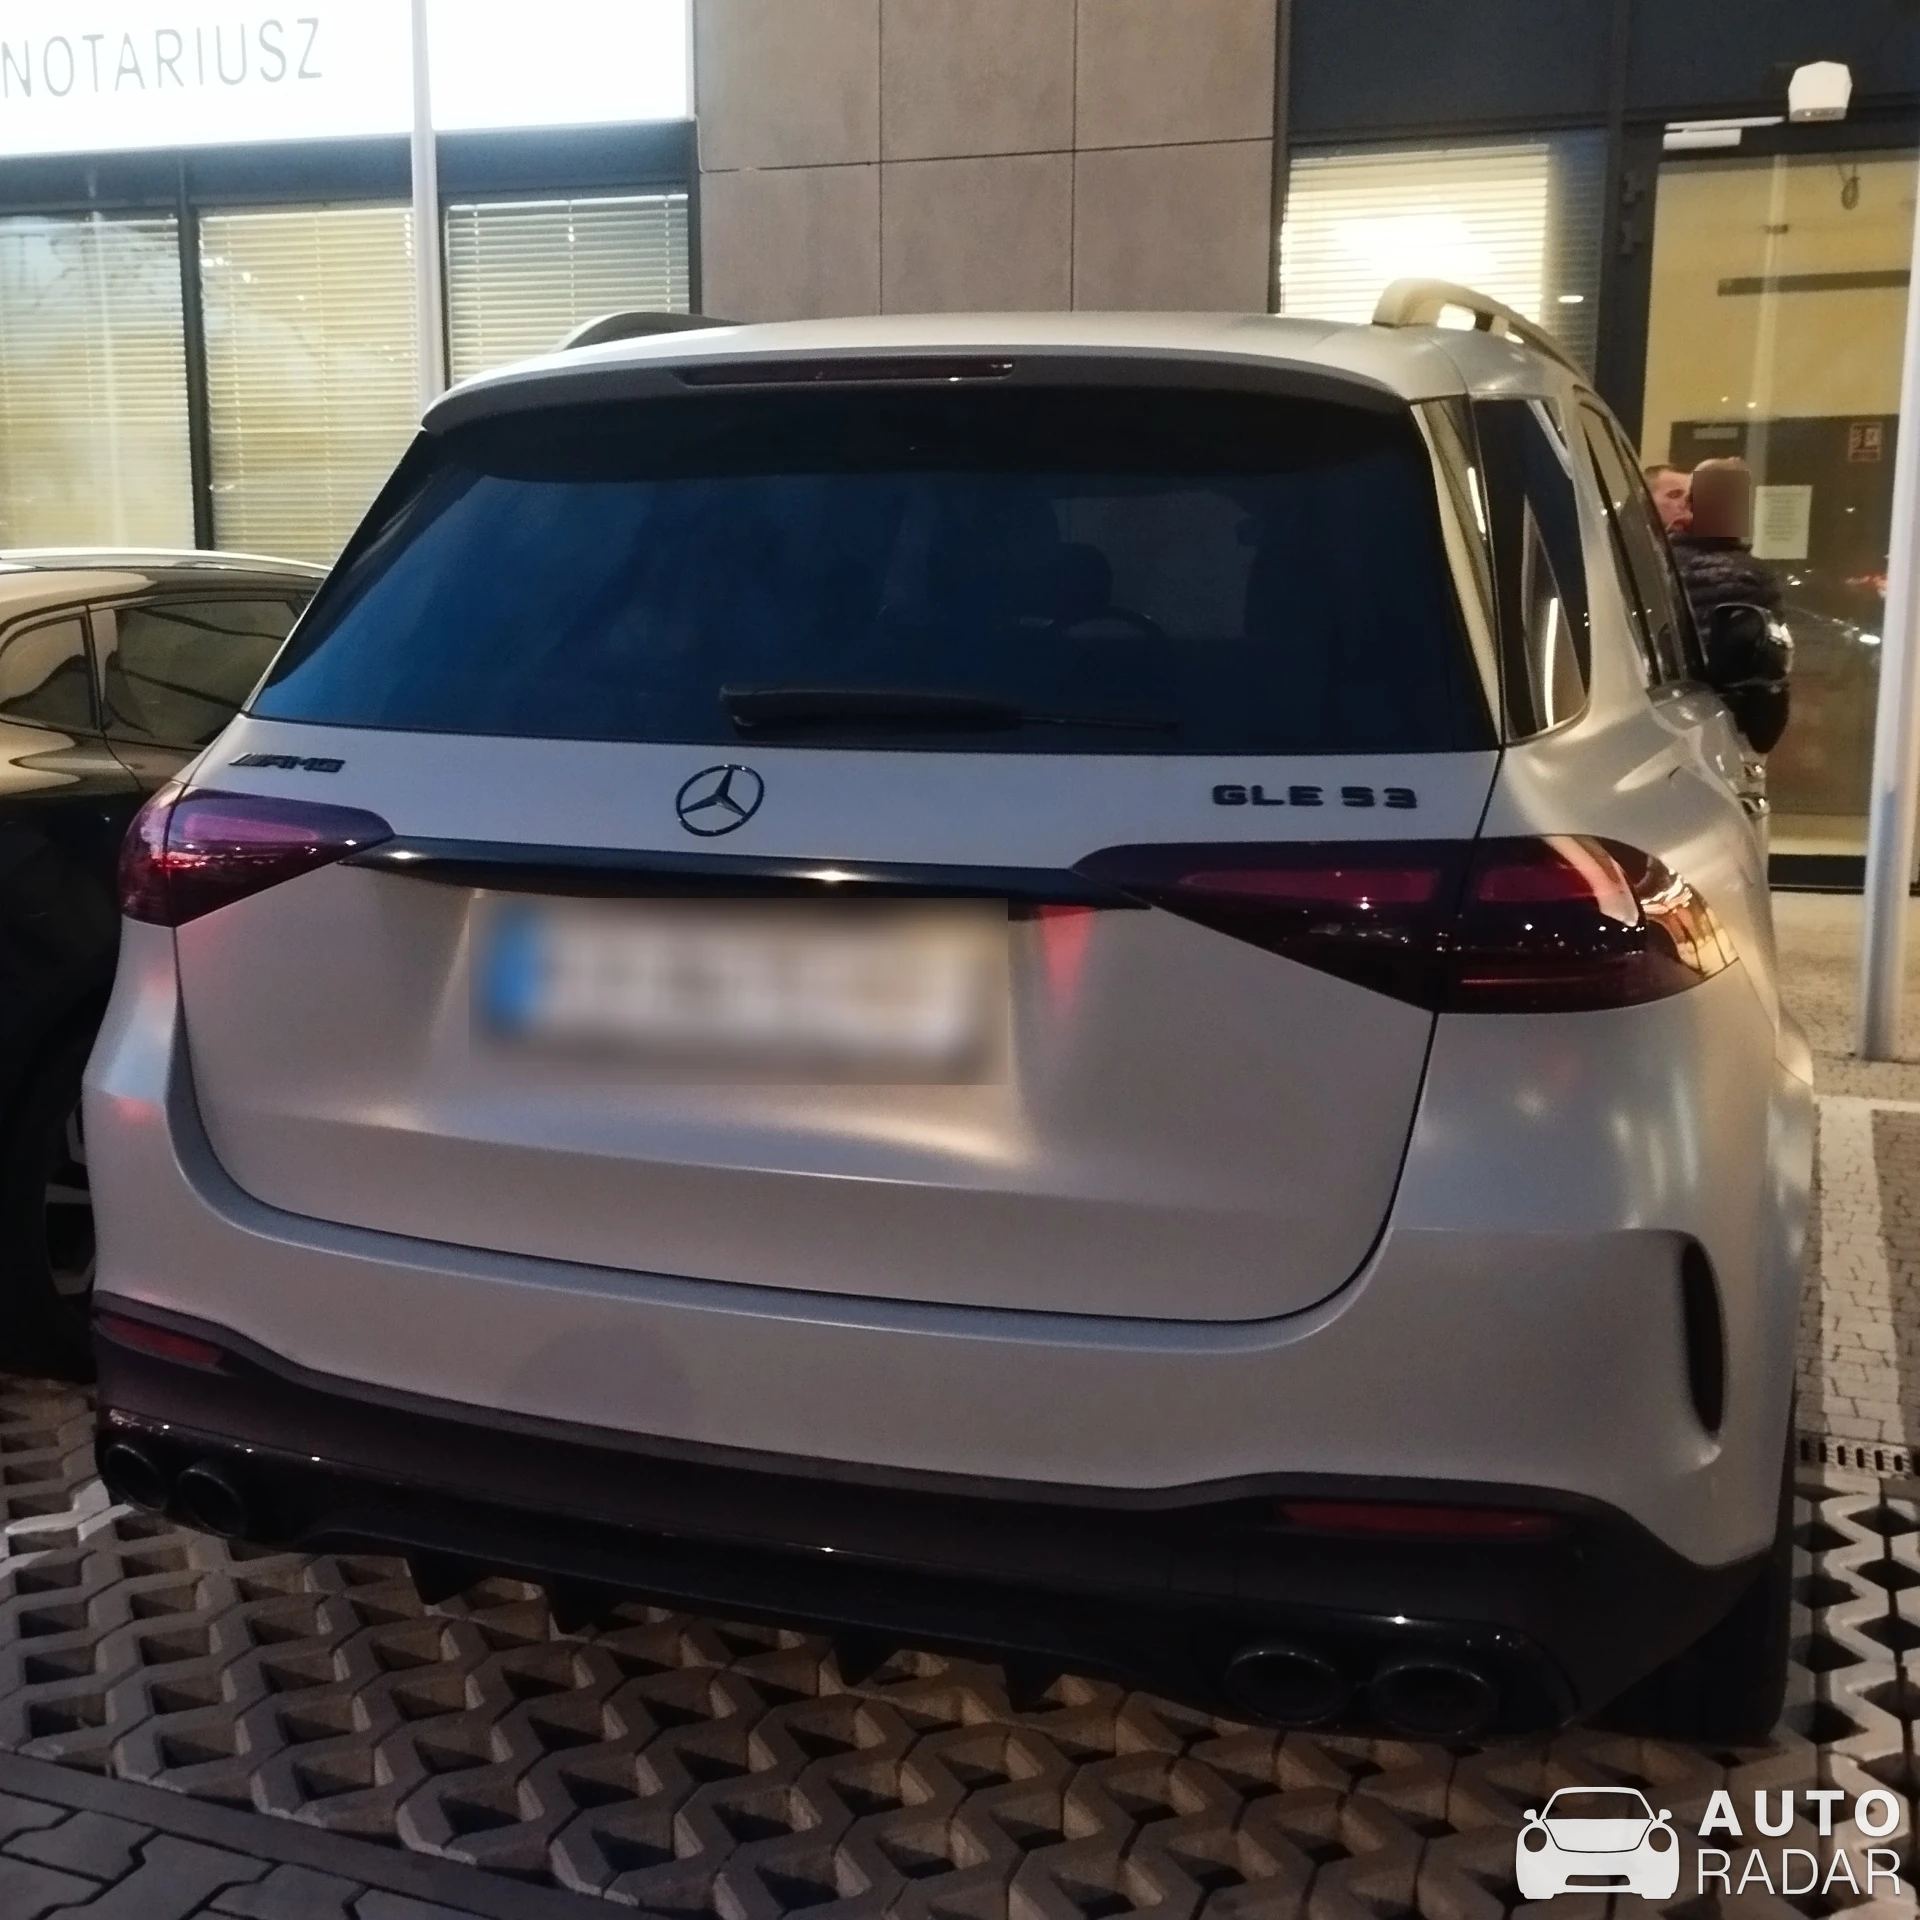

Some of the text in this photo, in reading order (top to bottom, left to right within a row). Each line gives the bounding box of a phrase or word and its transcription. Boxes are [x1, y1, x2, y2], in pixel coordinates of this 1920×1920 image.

[1, 17, 323, 99] NOTARIUSZ
[250, 753, 346, 773] AMG
[1212, 784, 1418, 809] GLE 53
